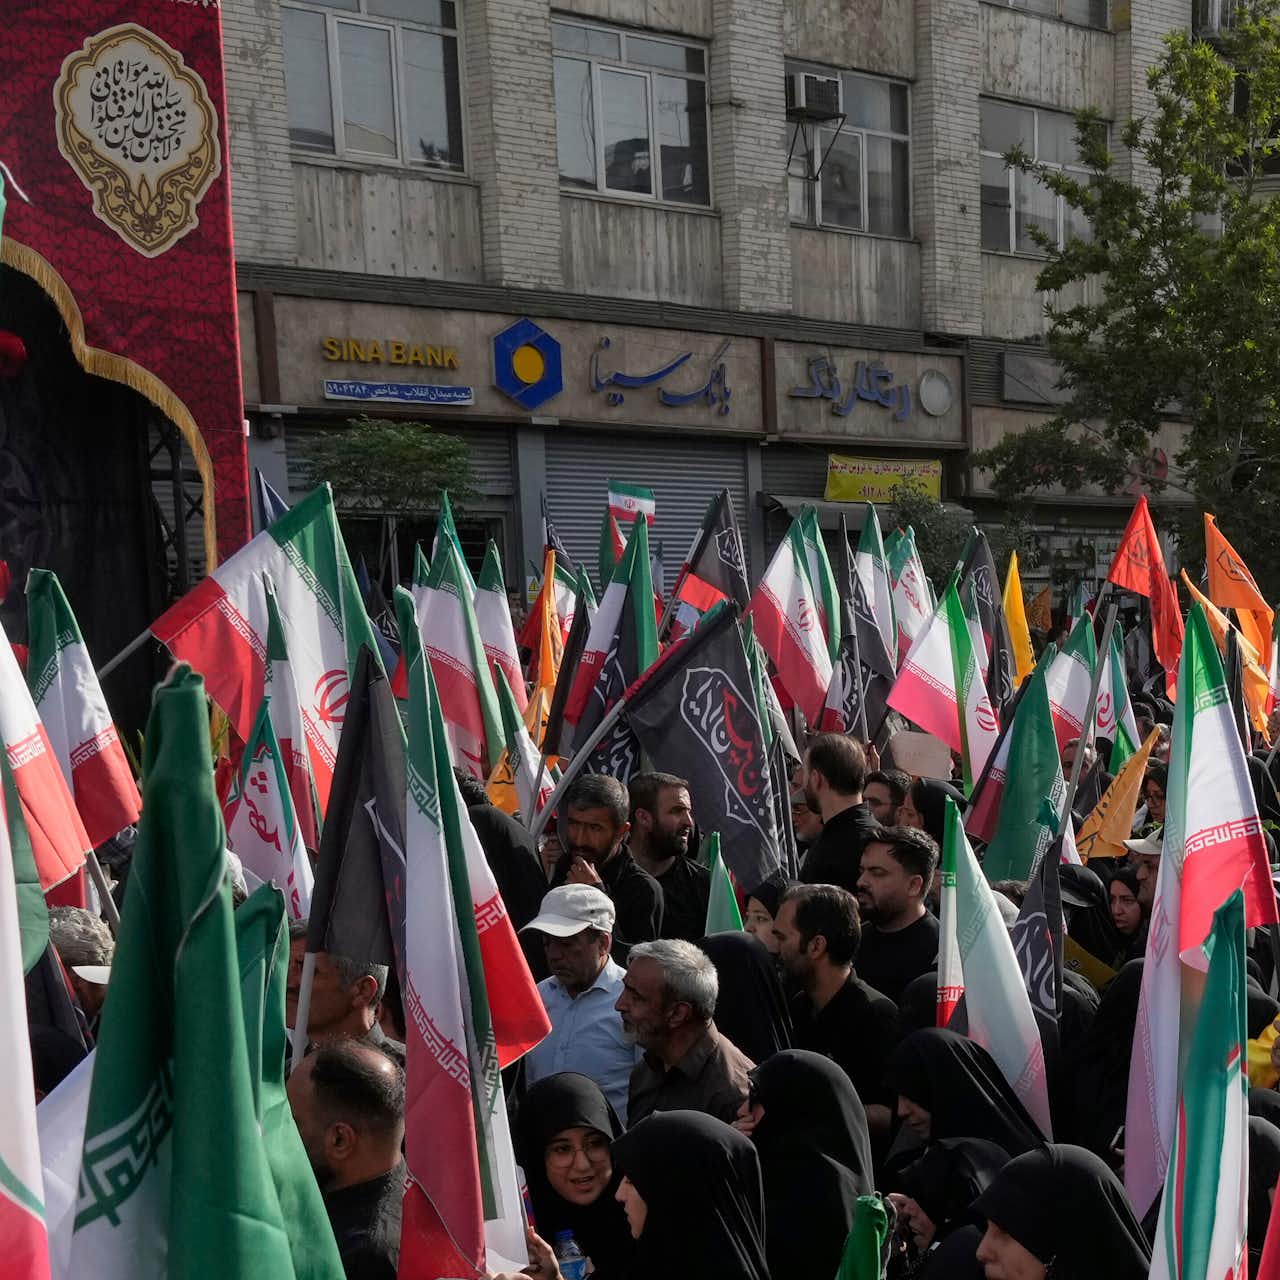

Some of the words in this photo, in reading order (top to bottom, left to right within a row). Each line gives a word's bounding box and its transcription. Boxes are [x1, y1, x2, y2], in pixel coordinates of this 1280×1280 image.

[322, 337, 385, 362] SINA
[391, 341, 460, 369] BANK
[589, 336, 694, 406] سینا
[658, 337, 733, 416] بانک
[404, 386, 429, 399] انقلاب
[429, 388, 452, 401] میدان
